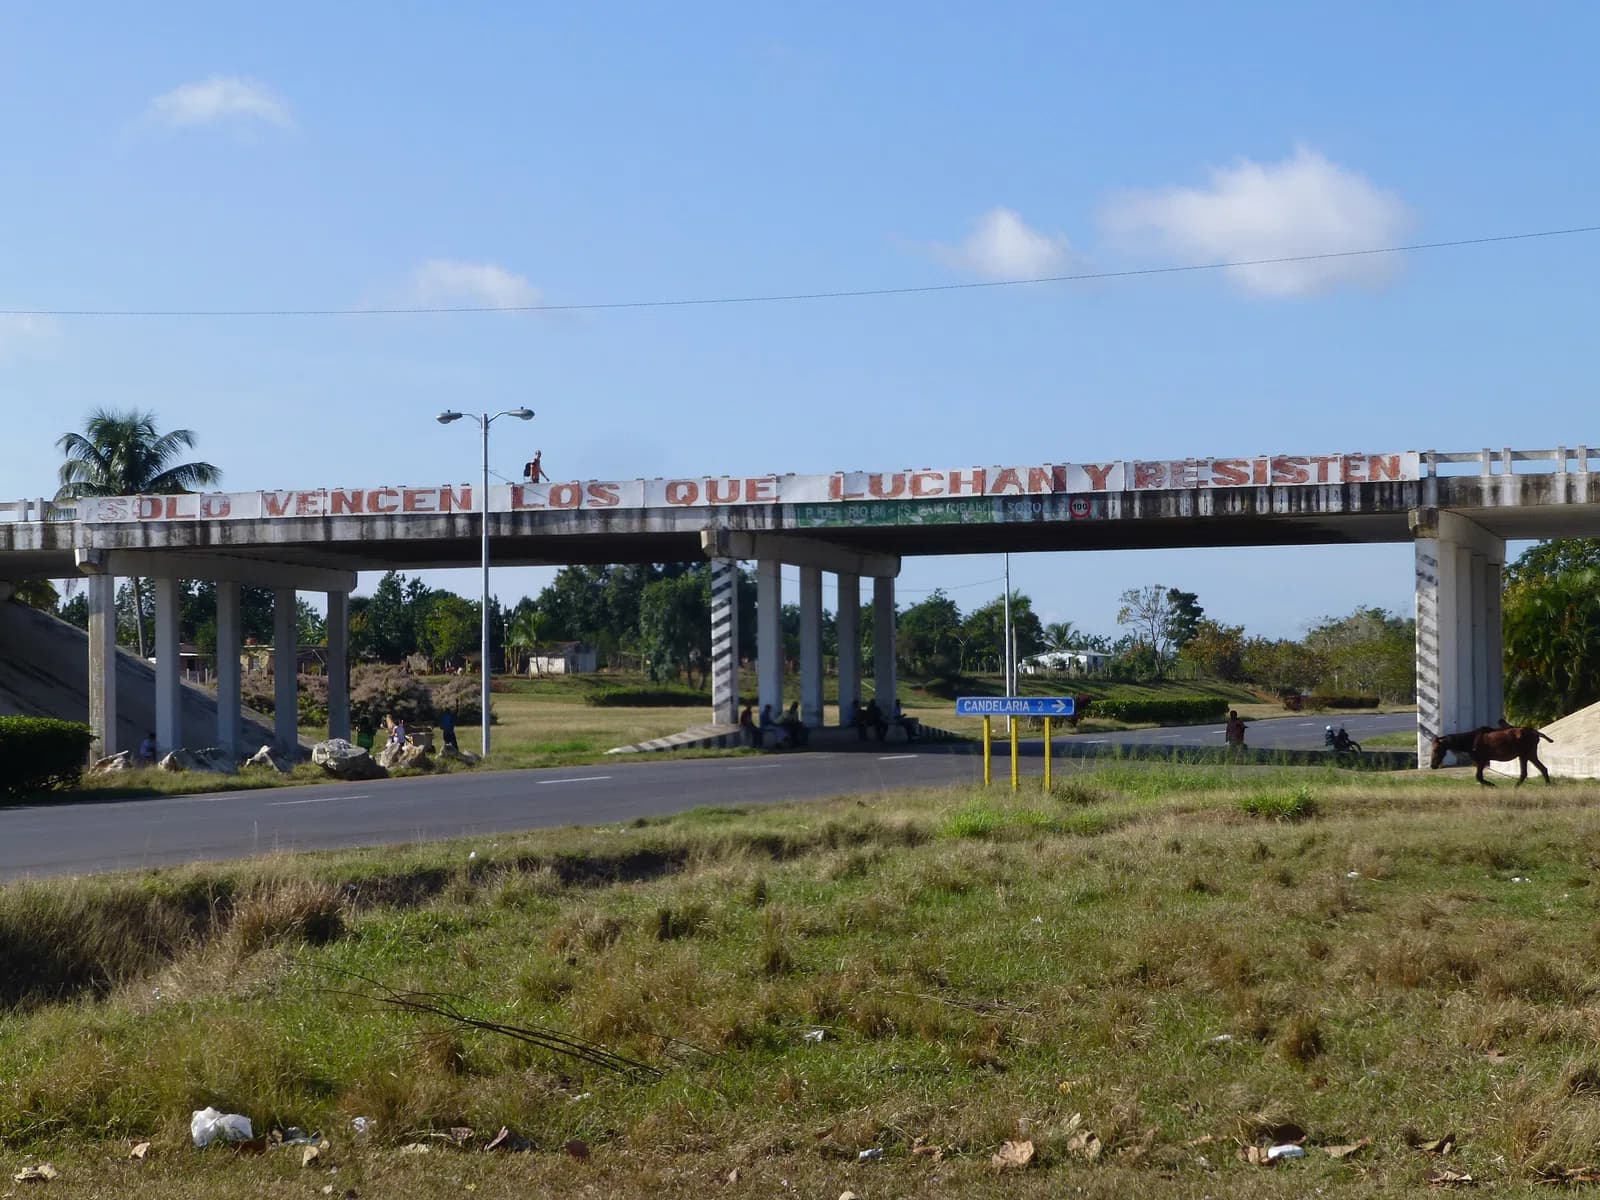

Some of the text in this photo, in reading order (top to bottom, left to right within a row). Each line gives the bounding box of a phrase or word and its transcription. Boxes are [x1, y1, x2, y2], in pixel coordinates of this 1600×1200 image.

[262, 487, 472, 517] VENCEN
[512, 483, 620, 509] LOS
[665, 478, 780, 506] QUE
[828, 465, 1067, 499] LUCHAN
[1082, 464, 1114, 490] Y
[963, 700, 1044, 712] CANDELARIA 2
